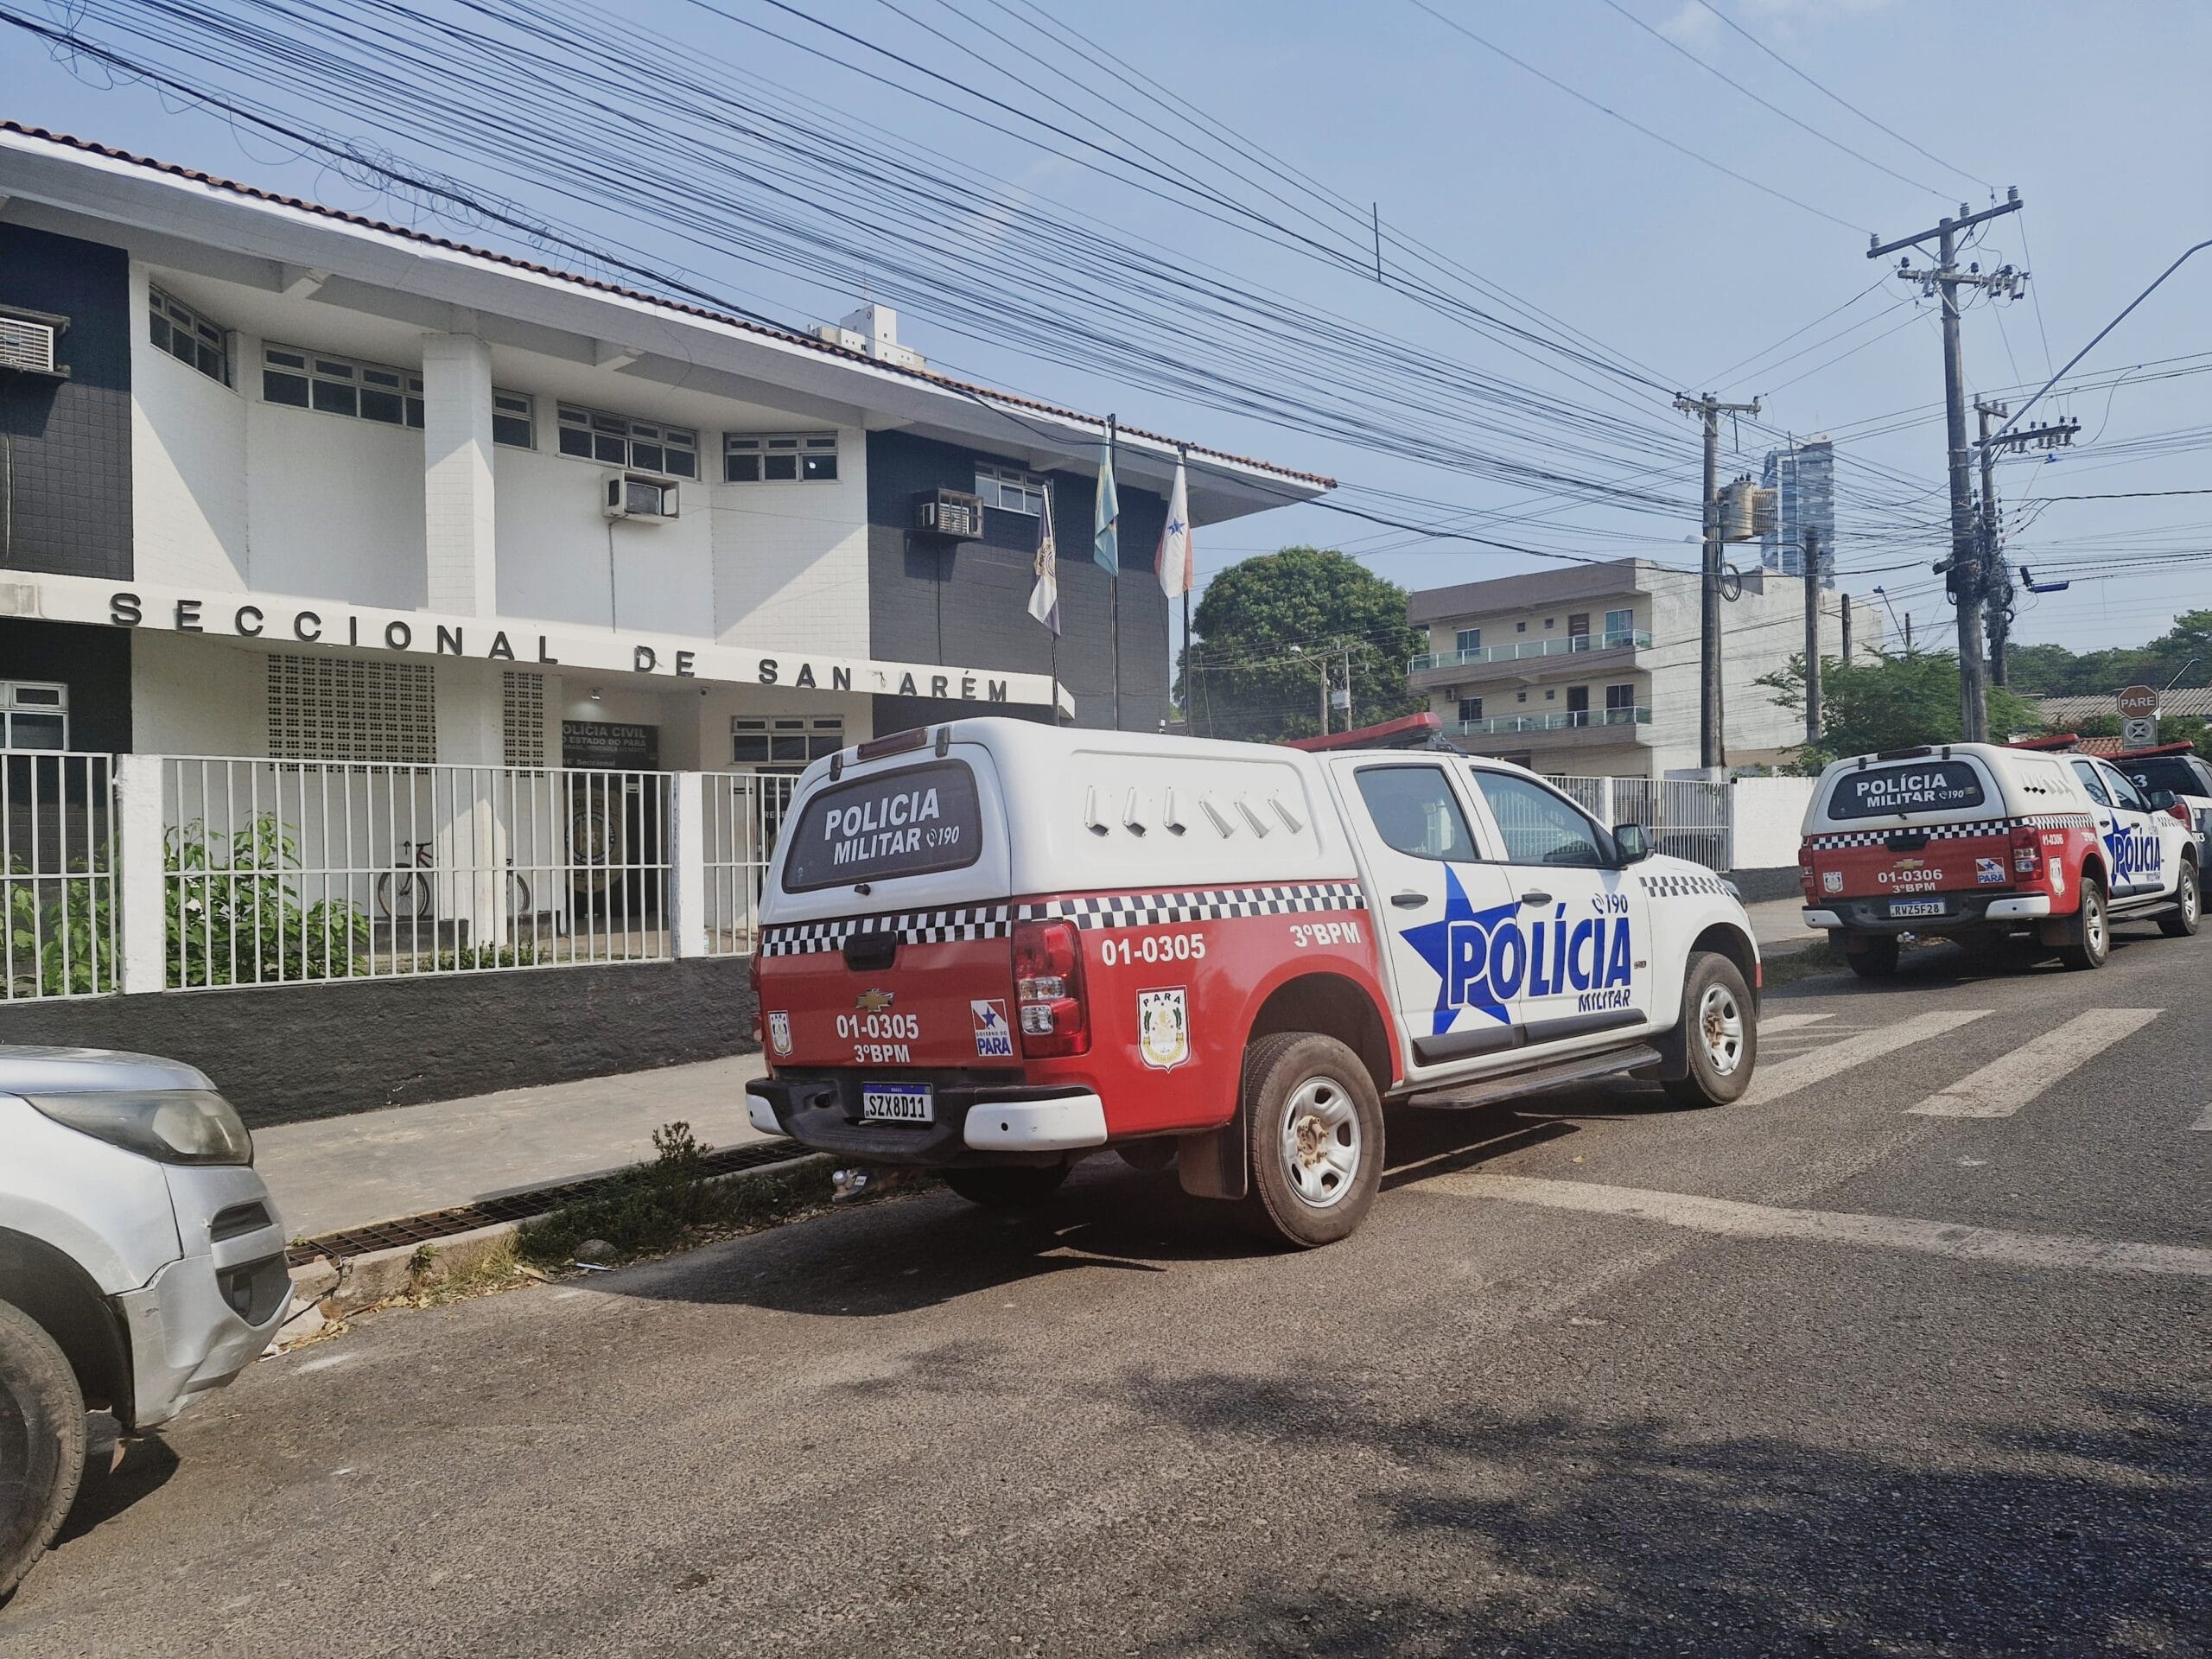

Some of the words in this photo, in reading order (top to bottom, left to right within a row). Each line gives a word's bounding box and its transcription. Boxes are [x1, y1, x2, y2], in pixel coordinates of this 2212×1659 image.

[110, 593, 558, 665] SECCIONAL
[634, 645, 696, 677] DE
[2120, 696, 2156, 709] PARE
[569, 736, 606, 746] ESTADO
[607, 738, 621, 747] DO
[612, 726, 647, 739] CIVIL
[1856, 772, 1948, 797] POLÍCIA
[1866, 790, 1936, 808] MILITAR
[1948, 790, 1965, 799] 190
[824, 787, 941, 842] POLICIA
[833, 826, 921, 865] MILITAR
[938, 825, 961, 846] 190
[2114, 827, 2160, 874] POLÍCIA
[1878, 868, 1943, 884] 01-0306
[1892, 882, 1936, 893] 3ºBPM
[1605, 893, 1629, 914] 190
[1895, 904, 1941, 916] RWZ5F28
[1289, 922, 1361, 947] 3ºBPM
[1102, 932, 1206, 966] 01-0305
[1449, 902, 1631, 1006] POLÍCIA
[1578, 988, 1631, 1013] MILITAR
[836, 1014, 919, 1039] 01-0305
[854, 1044, 911, 1063] 3ºBPM
[869, 1095, 925, 1118] SZX8D11
